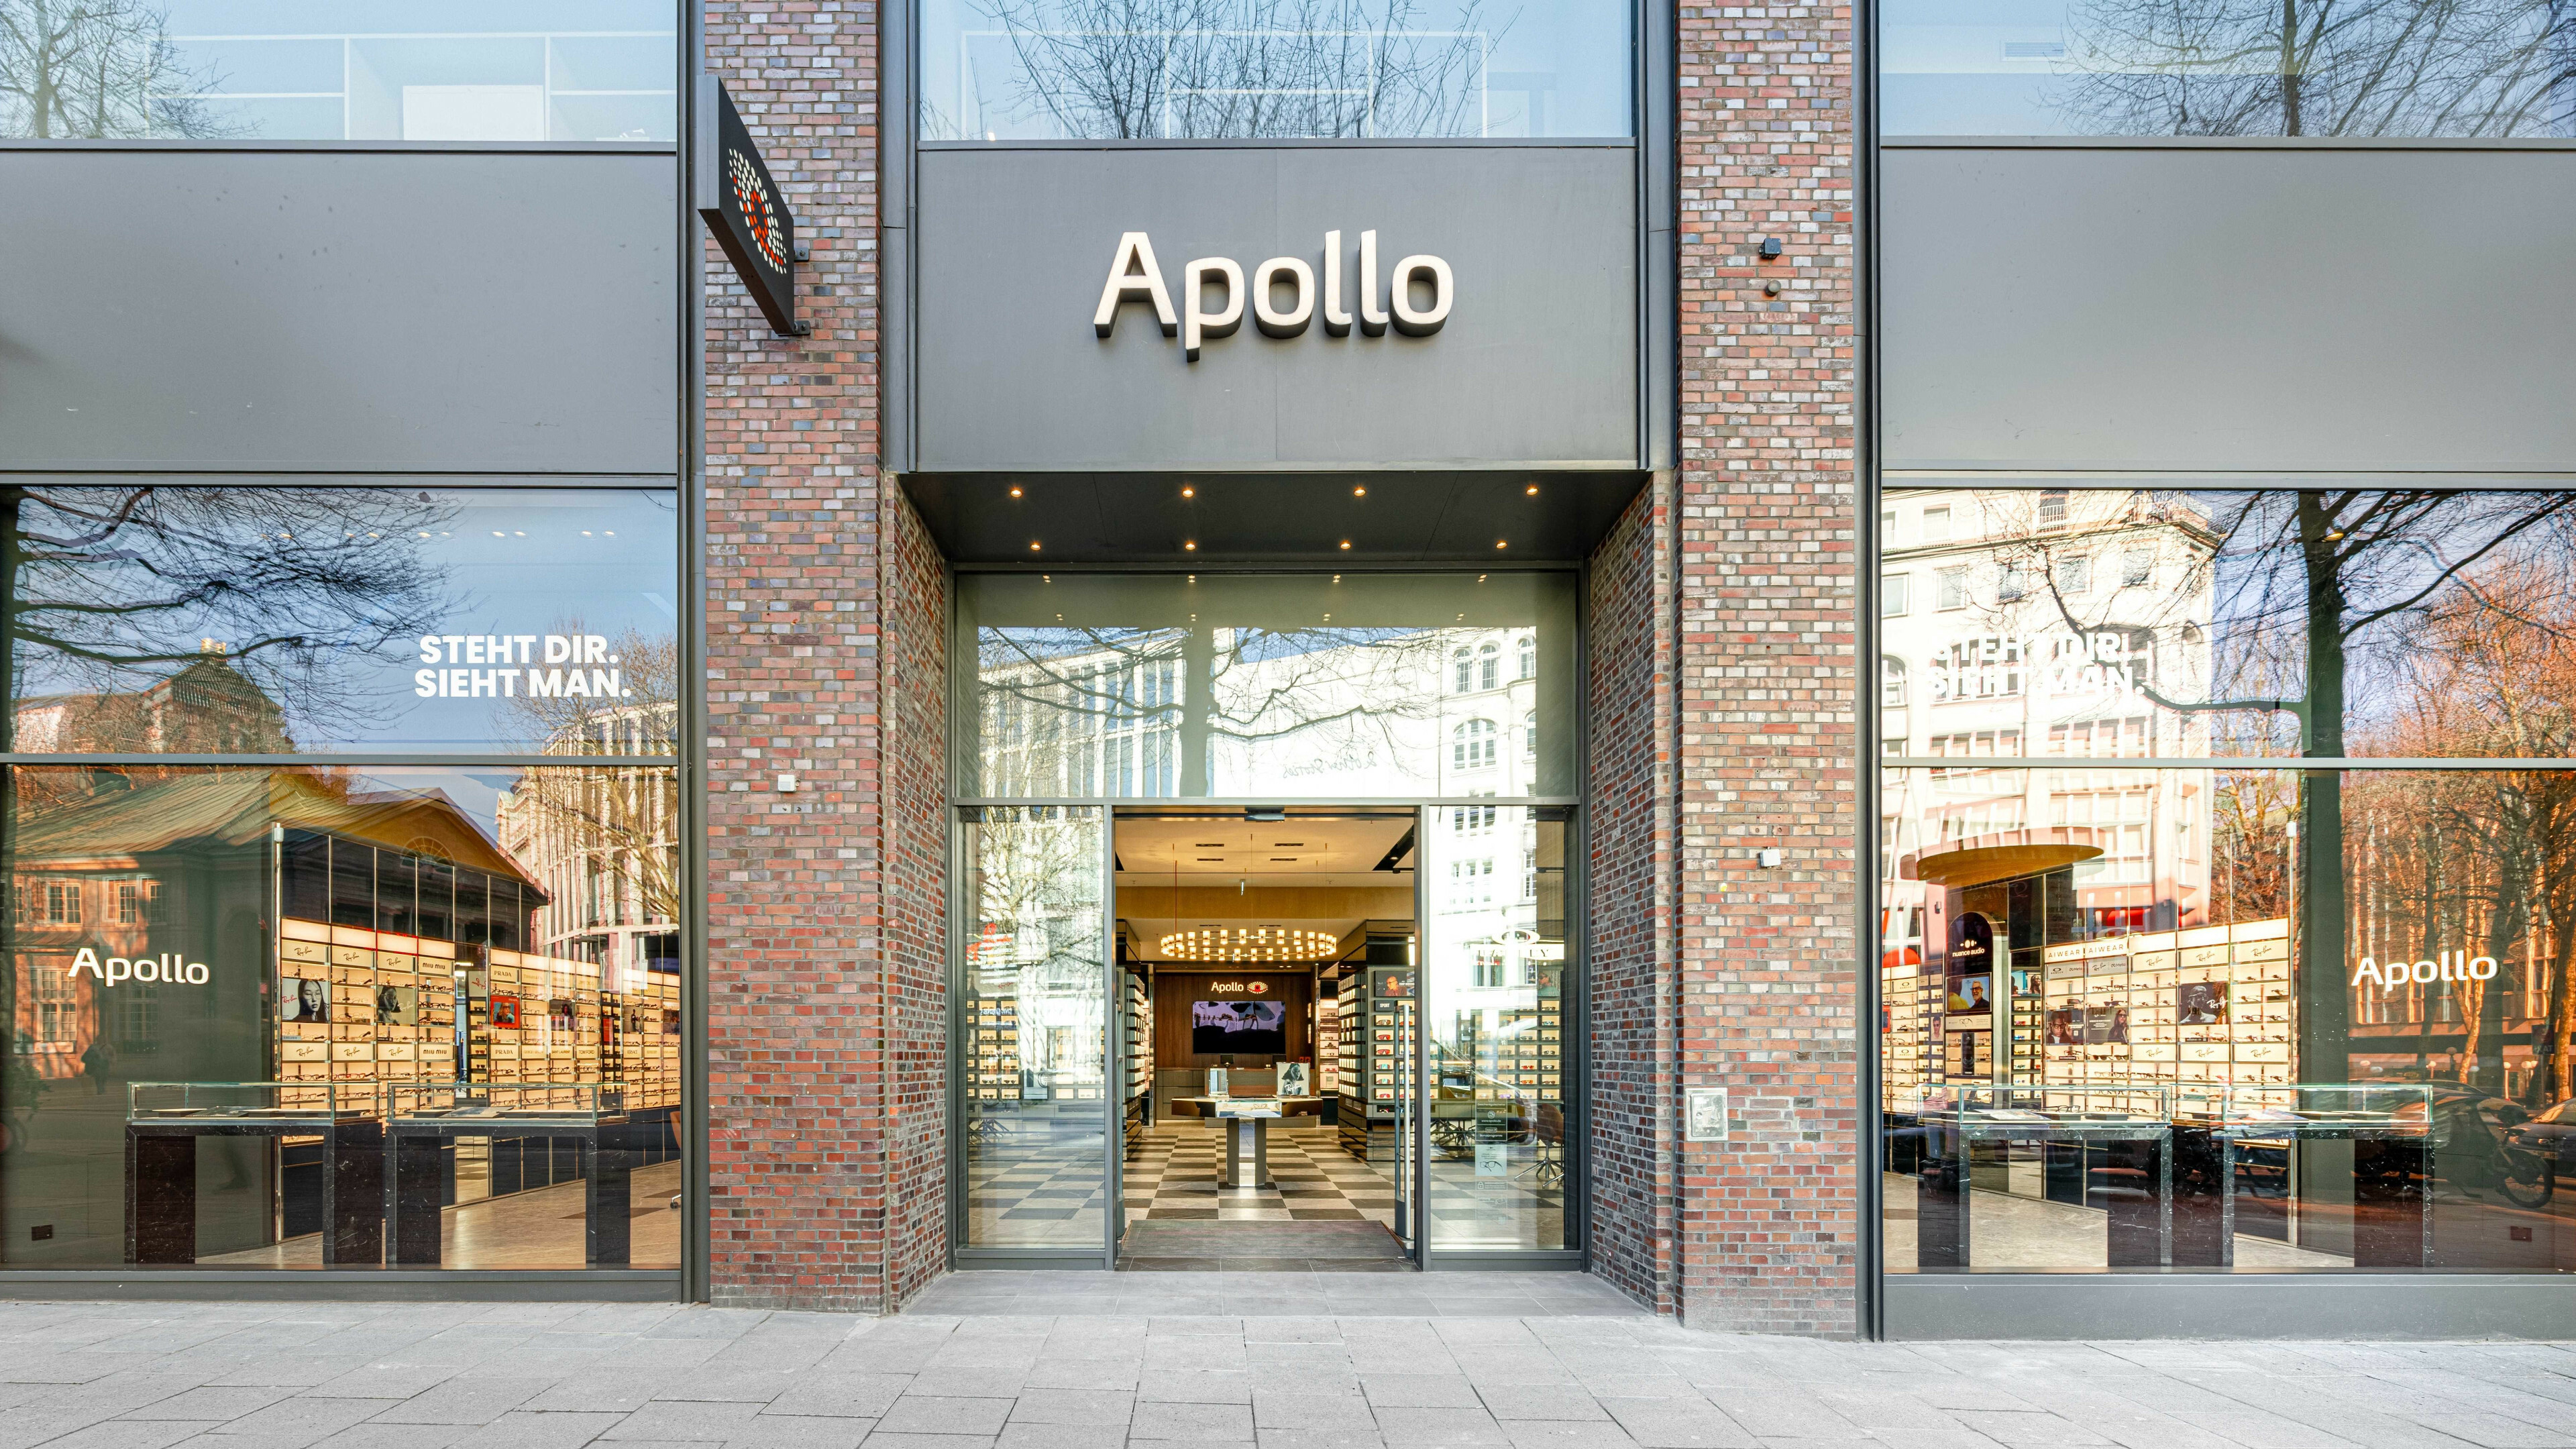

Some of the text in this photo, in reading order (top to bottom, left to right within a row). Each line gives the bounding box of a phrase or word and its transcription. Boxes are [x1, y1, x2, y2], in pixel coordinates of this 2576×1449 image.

[1093, 229, 1454, 360] Apollo
[419, 635, 619, 664] STEHT DIR.
[414, 668, 631, 698] SIEHT MAN.
[2089, 944, 2124, 953] AIWEAR
[68, 947, 209, 987] Apollo
[2351, 949, 2499, 992] Apollo
[1211, 981, 1244, 994] Apollo
